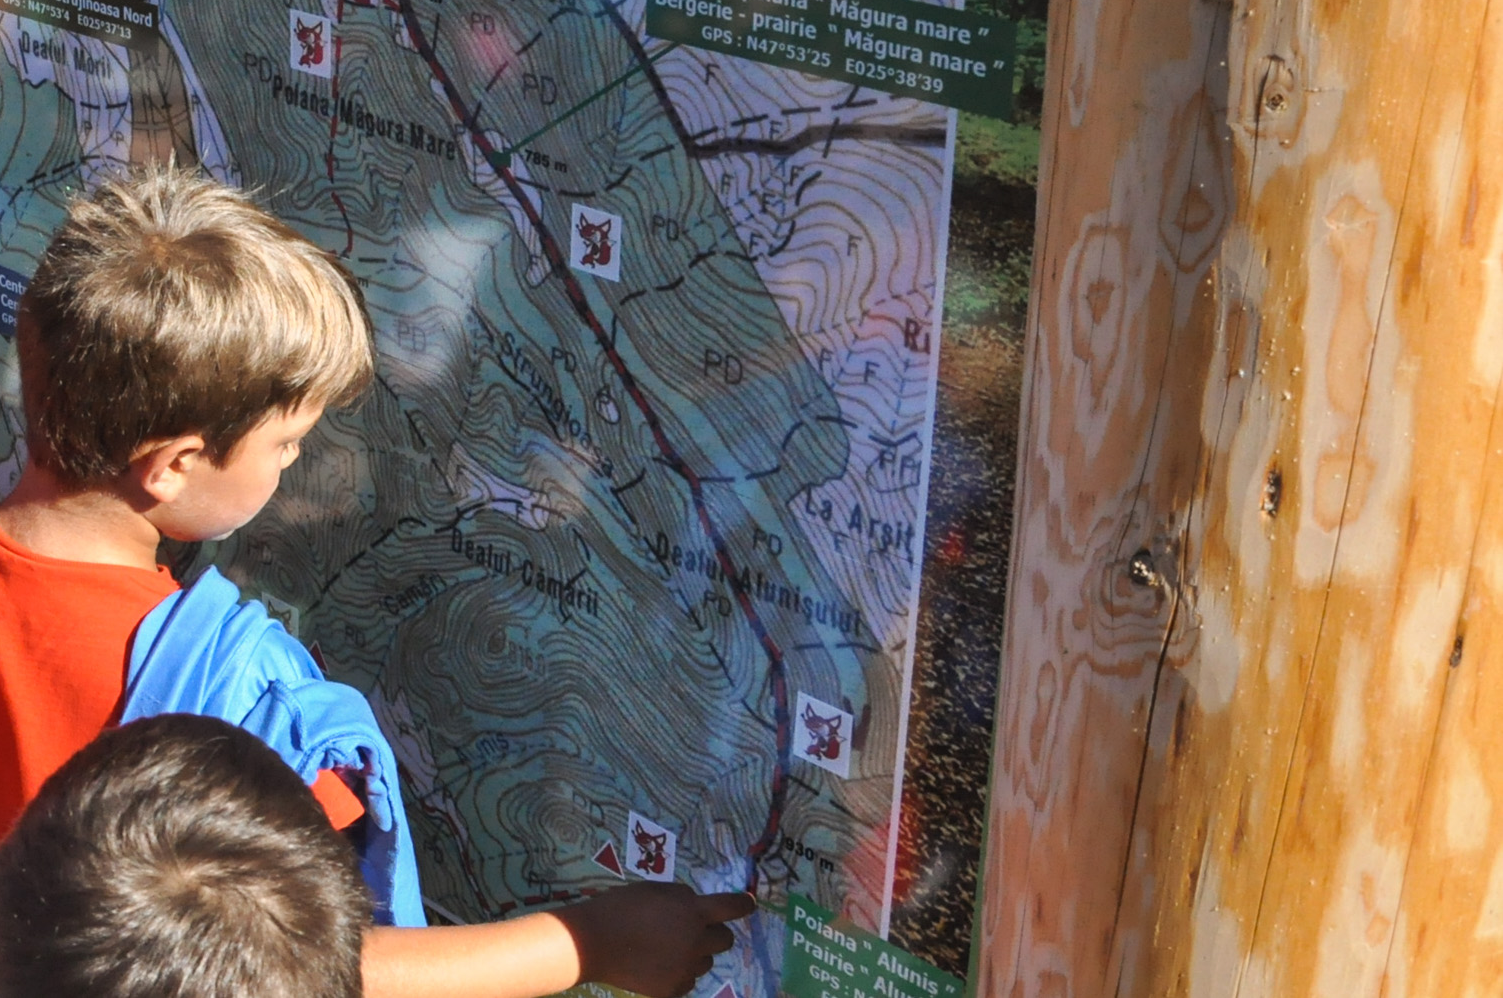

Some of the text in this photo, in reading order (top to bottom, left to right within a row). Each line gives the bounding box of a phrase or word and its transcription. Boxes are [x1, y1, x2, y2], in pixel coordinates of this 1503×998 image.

[123, 5, 153, 28] Nord
[701, 25, 734, 46] GPS
[751, 12, 817, 40] prairie
[844, 22, 924, 62] Măgura
[929, 53, 987, 78] mare
[914, 20, 971, 45] mare
[794, 905, 857, 953] Poiana
[792, 930, 854, 977] Prairie
[809, 964, 841, 991] GPS
